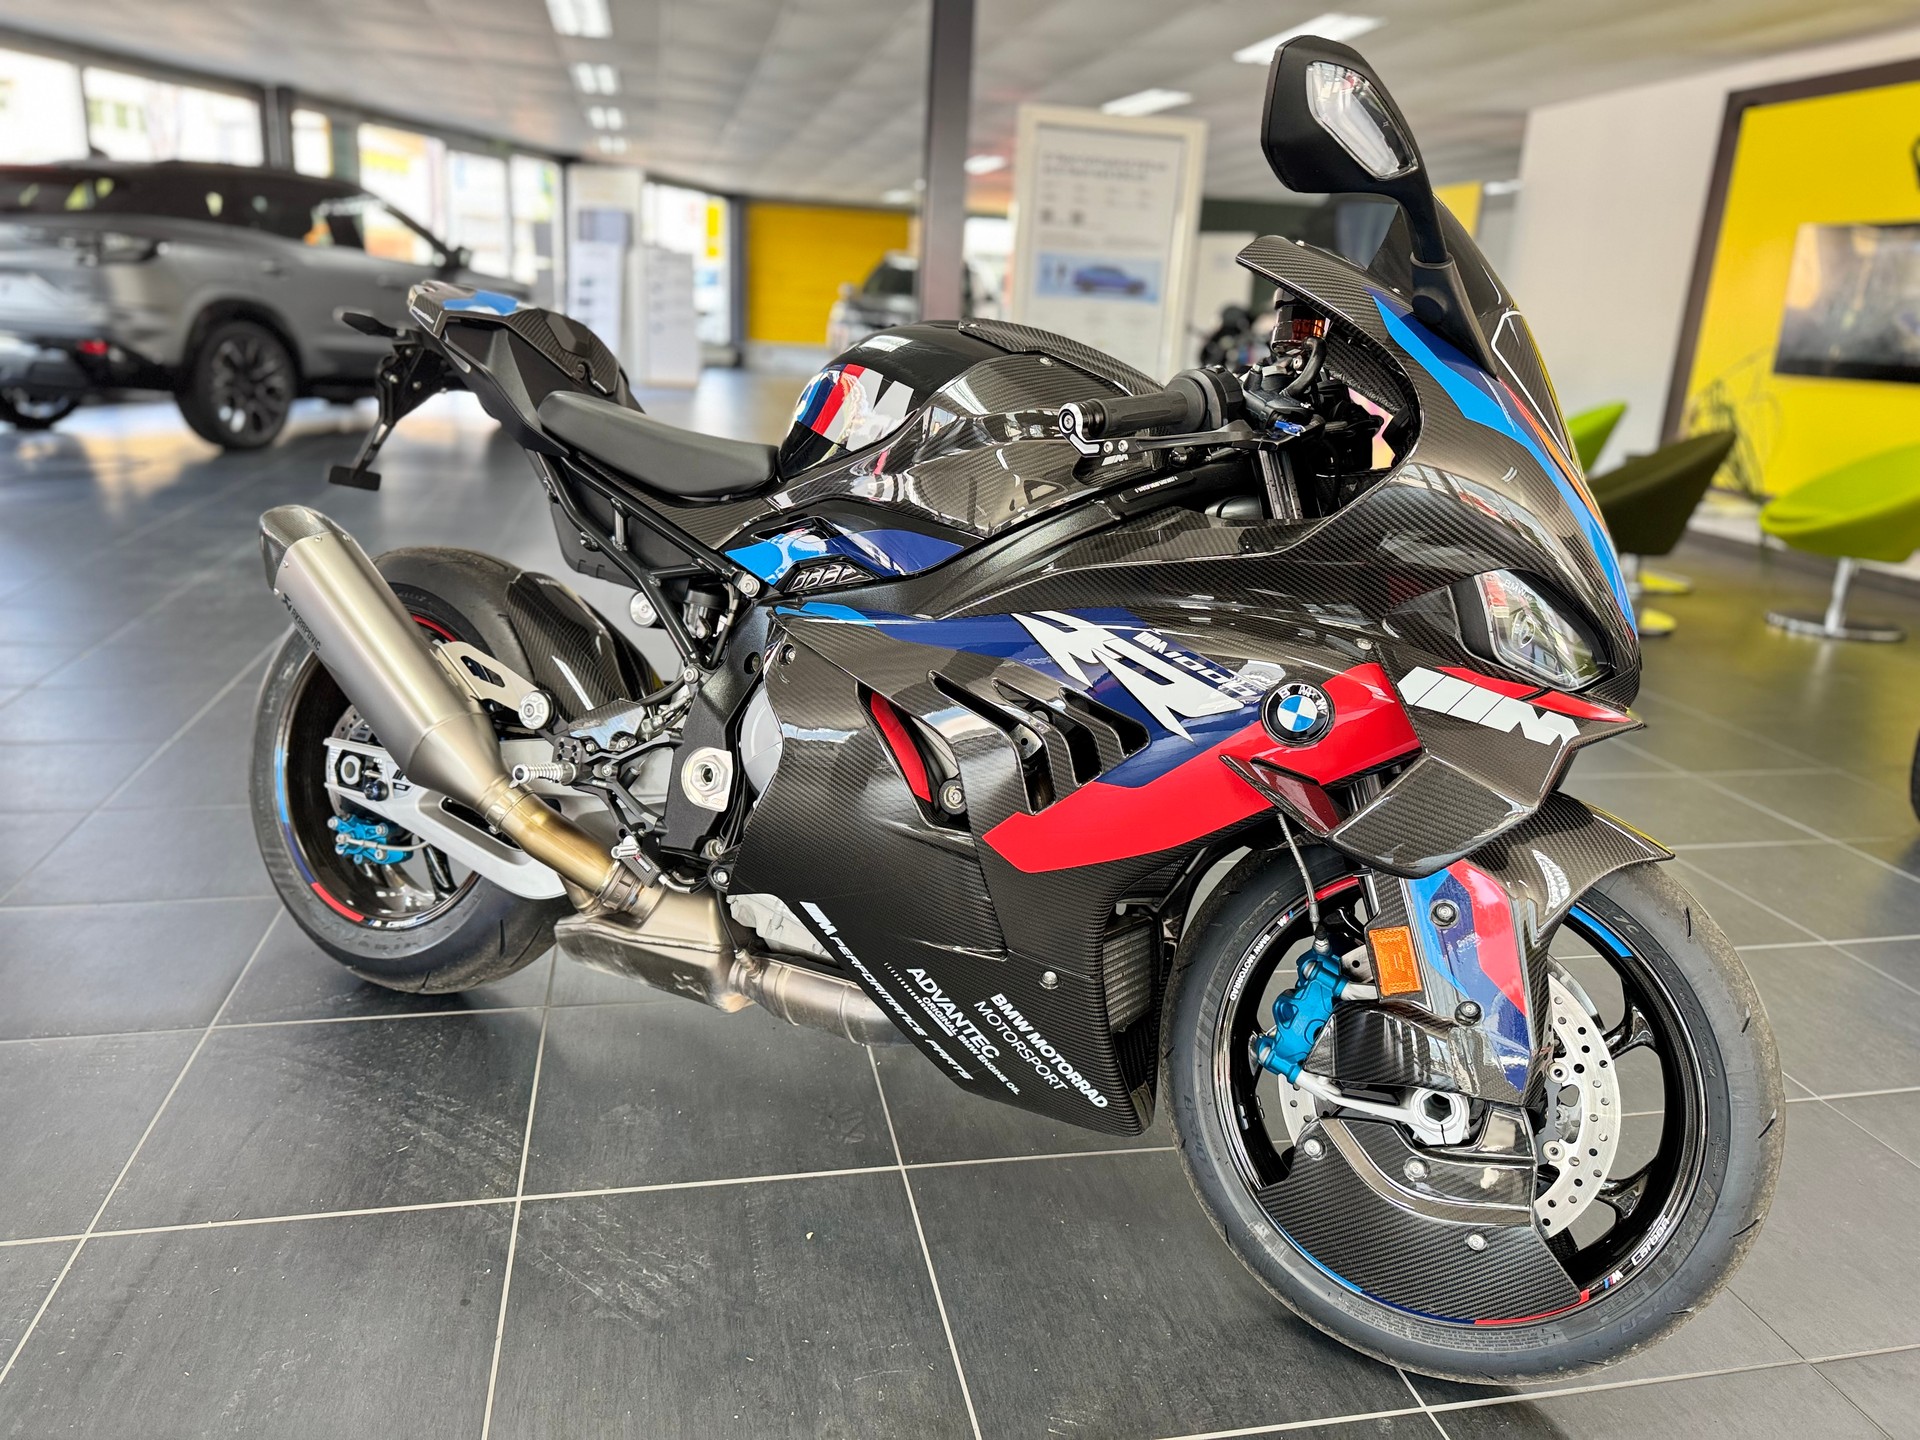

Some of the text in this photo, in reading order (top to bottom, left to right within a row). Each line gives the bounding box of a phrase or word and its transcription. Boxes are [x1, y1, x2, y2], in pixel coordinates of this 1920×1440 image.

[1278, 684, 1329, 716] BMW
[1229, 953, 1257, 1001] MOTORRAD
[1253, 934, 1271, 955] BMW
[829, 936, 928, 1036] PERFORMANCE
[925, 1039, 974, 1080] PARTS
[906, 968, 1000, 1059] ADVANTEC
[922, 996, 1020, 1095] ORIGINAL BMW ENGINE OIL
[973, 1001, 1069, 1090] MOTORSPORT
[990, 993, 1108, 1108] BMW MOTORRAD
[1631, 1215, 1670, 1266] Carbon
